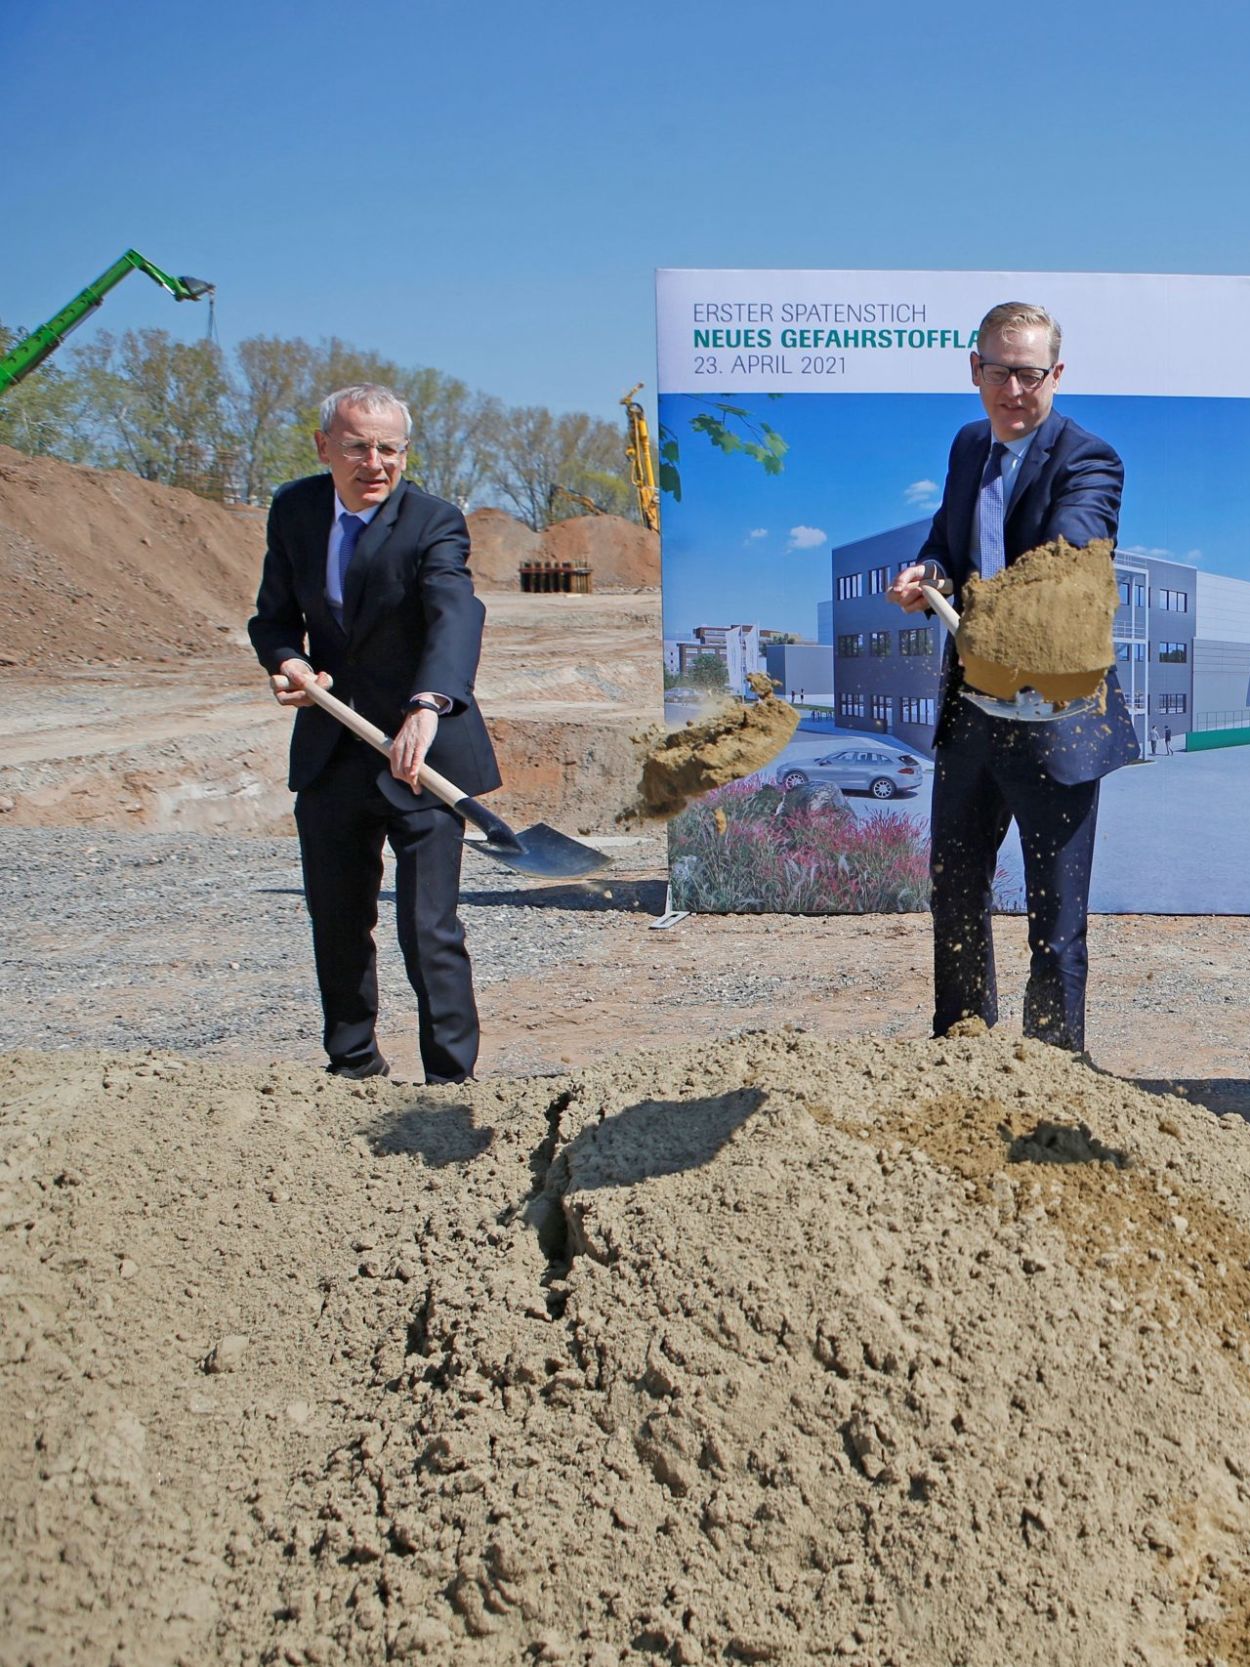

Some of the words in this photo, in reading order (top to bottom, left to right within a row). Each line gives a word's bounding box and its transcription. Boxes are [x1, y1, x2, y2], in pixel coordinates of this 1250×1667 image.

[693, 303, 773, 323] ERSTER
[781, 303, 926, 323] SPATENSTICH
[694, 329, 772, 348] NEUES
[694, 356, 723, 375] 23.
[730, 355, 792, 374] APRIL
[801, 356, 846, 374] 2021
